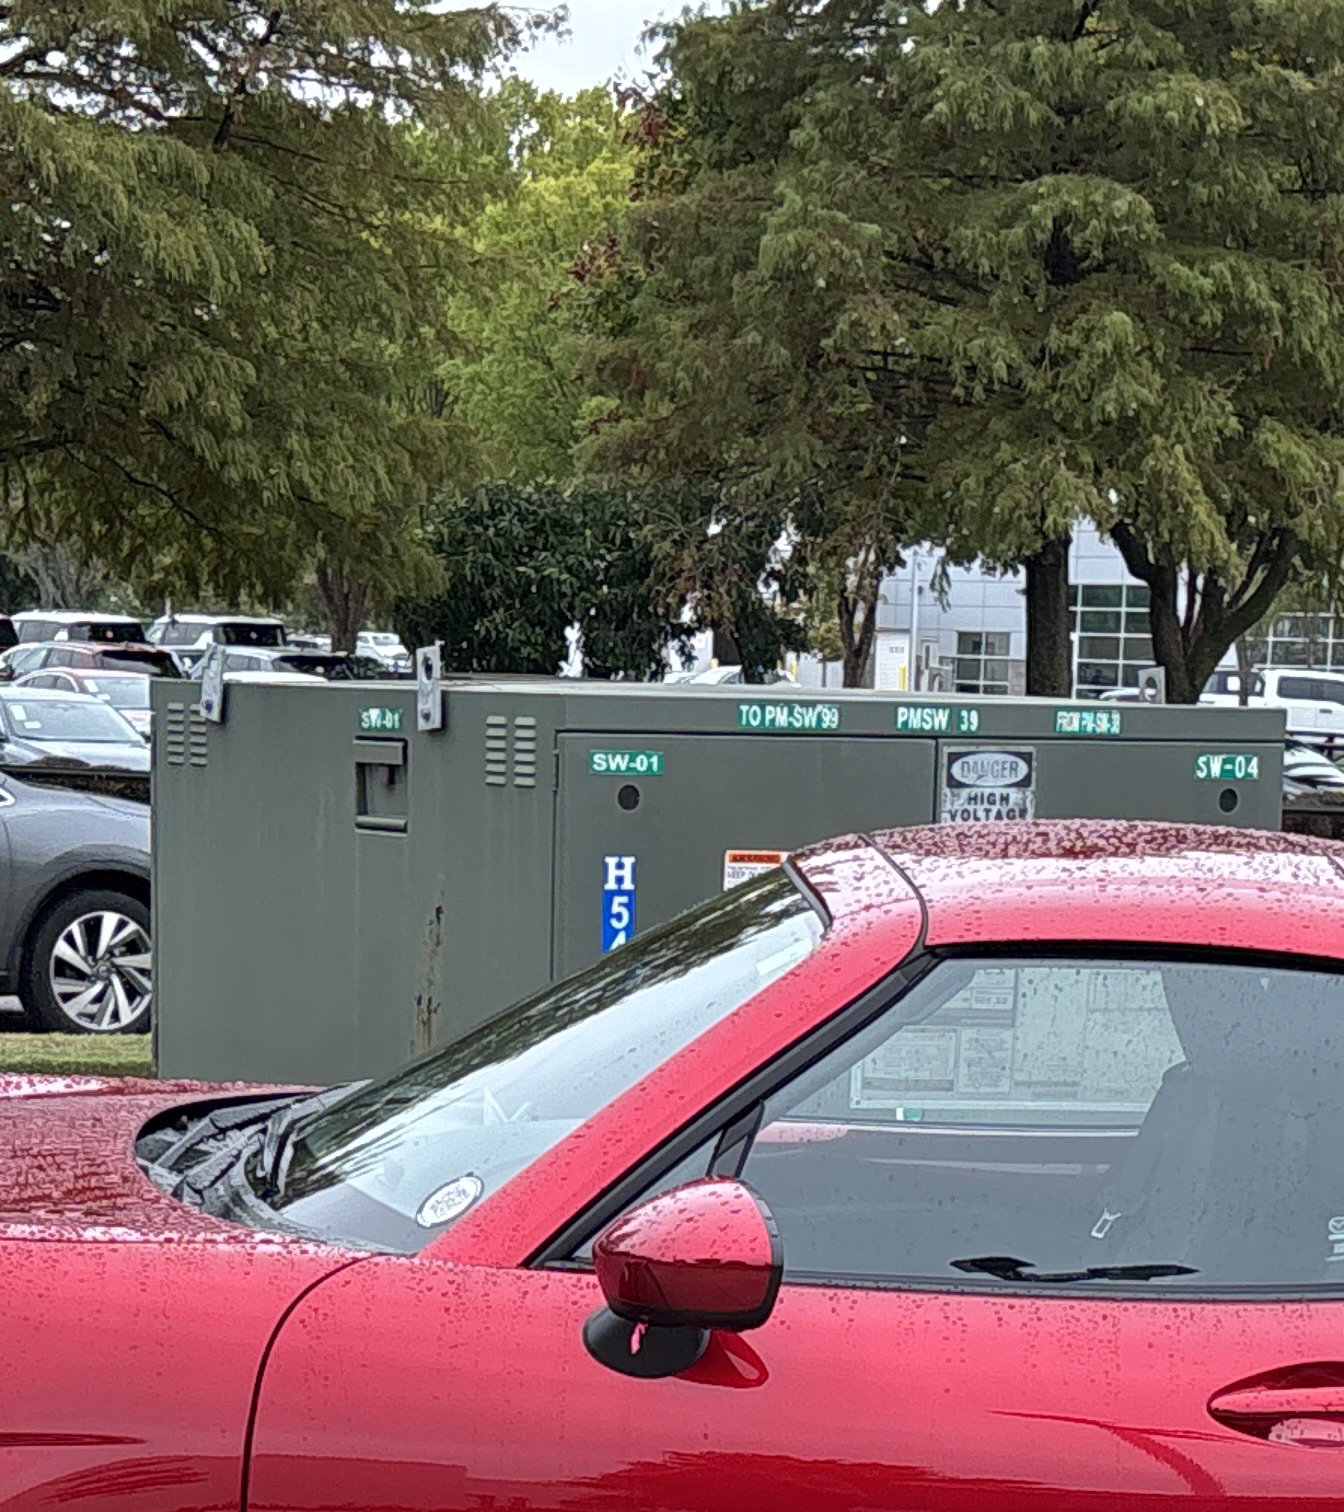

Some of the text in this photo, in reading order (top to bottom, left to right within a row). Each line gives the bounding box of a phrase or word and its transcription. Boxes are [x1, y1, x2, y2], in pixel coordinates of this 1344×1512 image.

[739, 704, 762, 727] TO
[897, 706, 979, 732] PMSW 39
[592, 753, 659, 772] SW-01
[1196, 755, 1259, 779] SW-04
[967, 792, 1010, 806] HIGH
